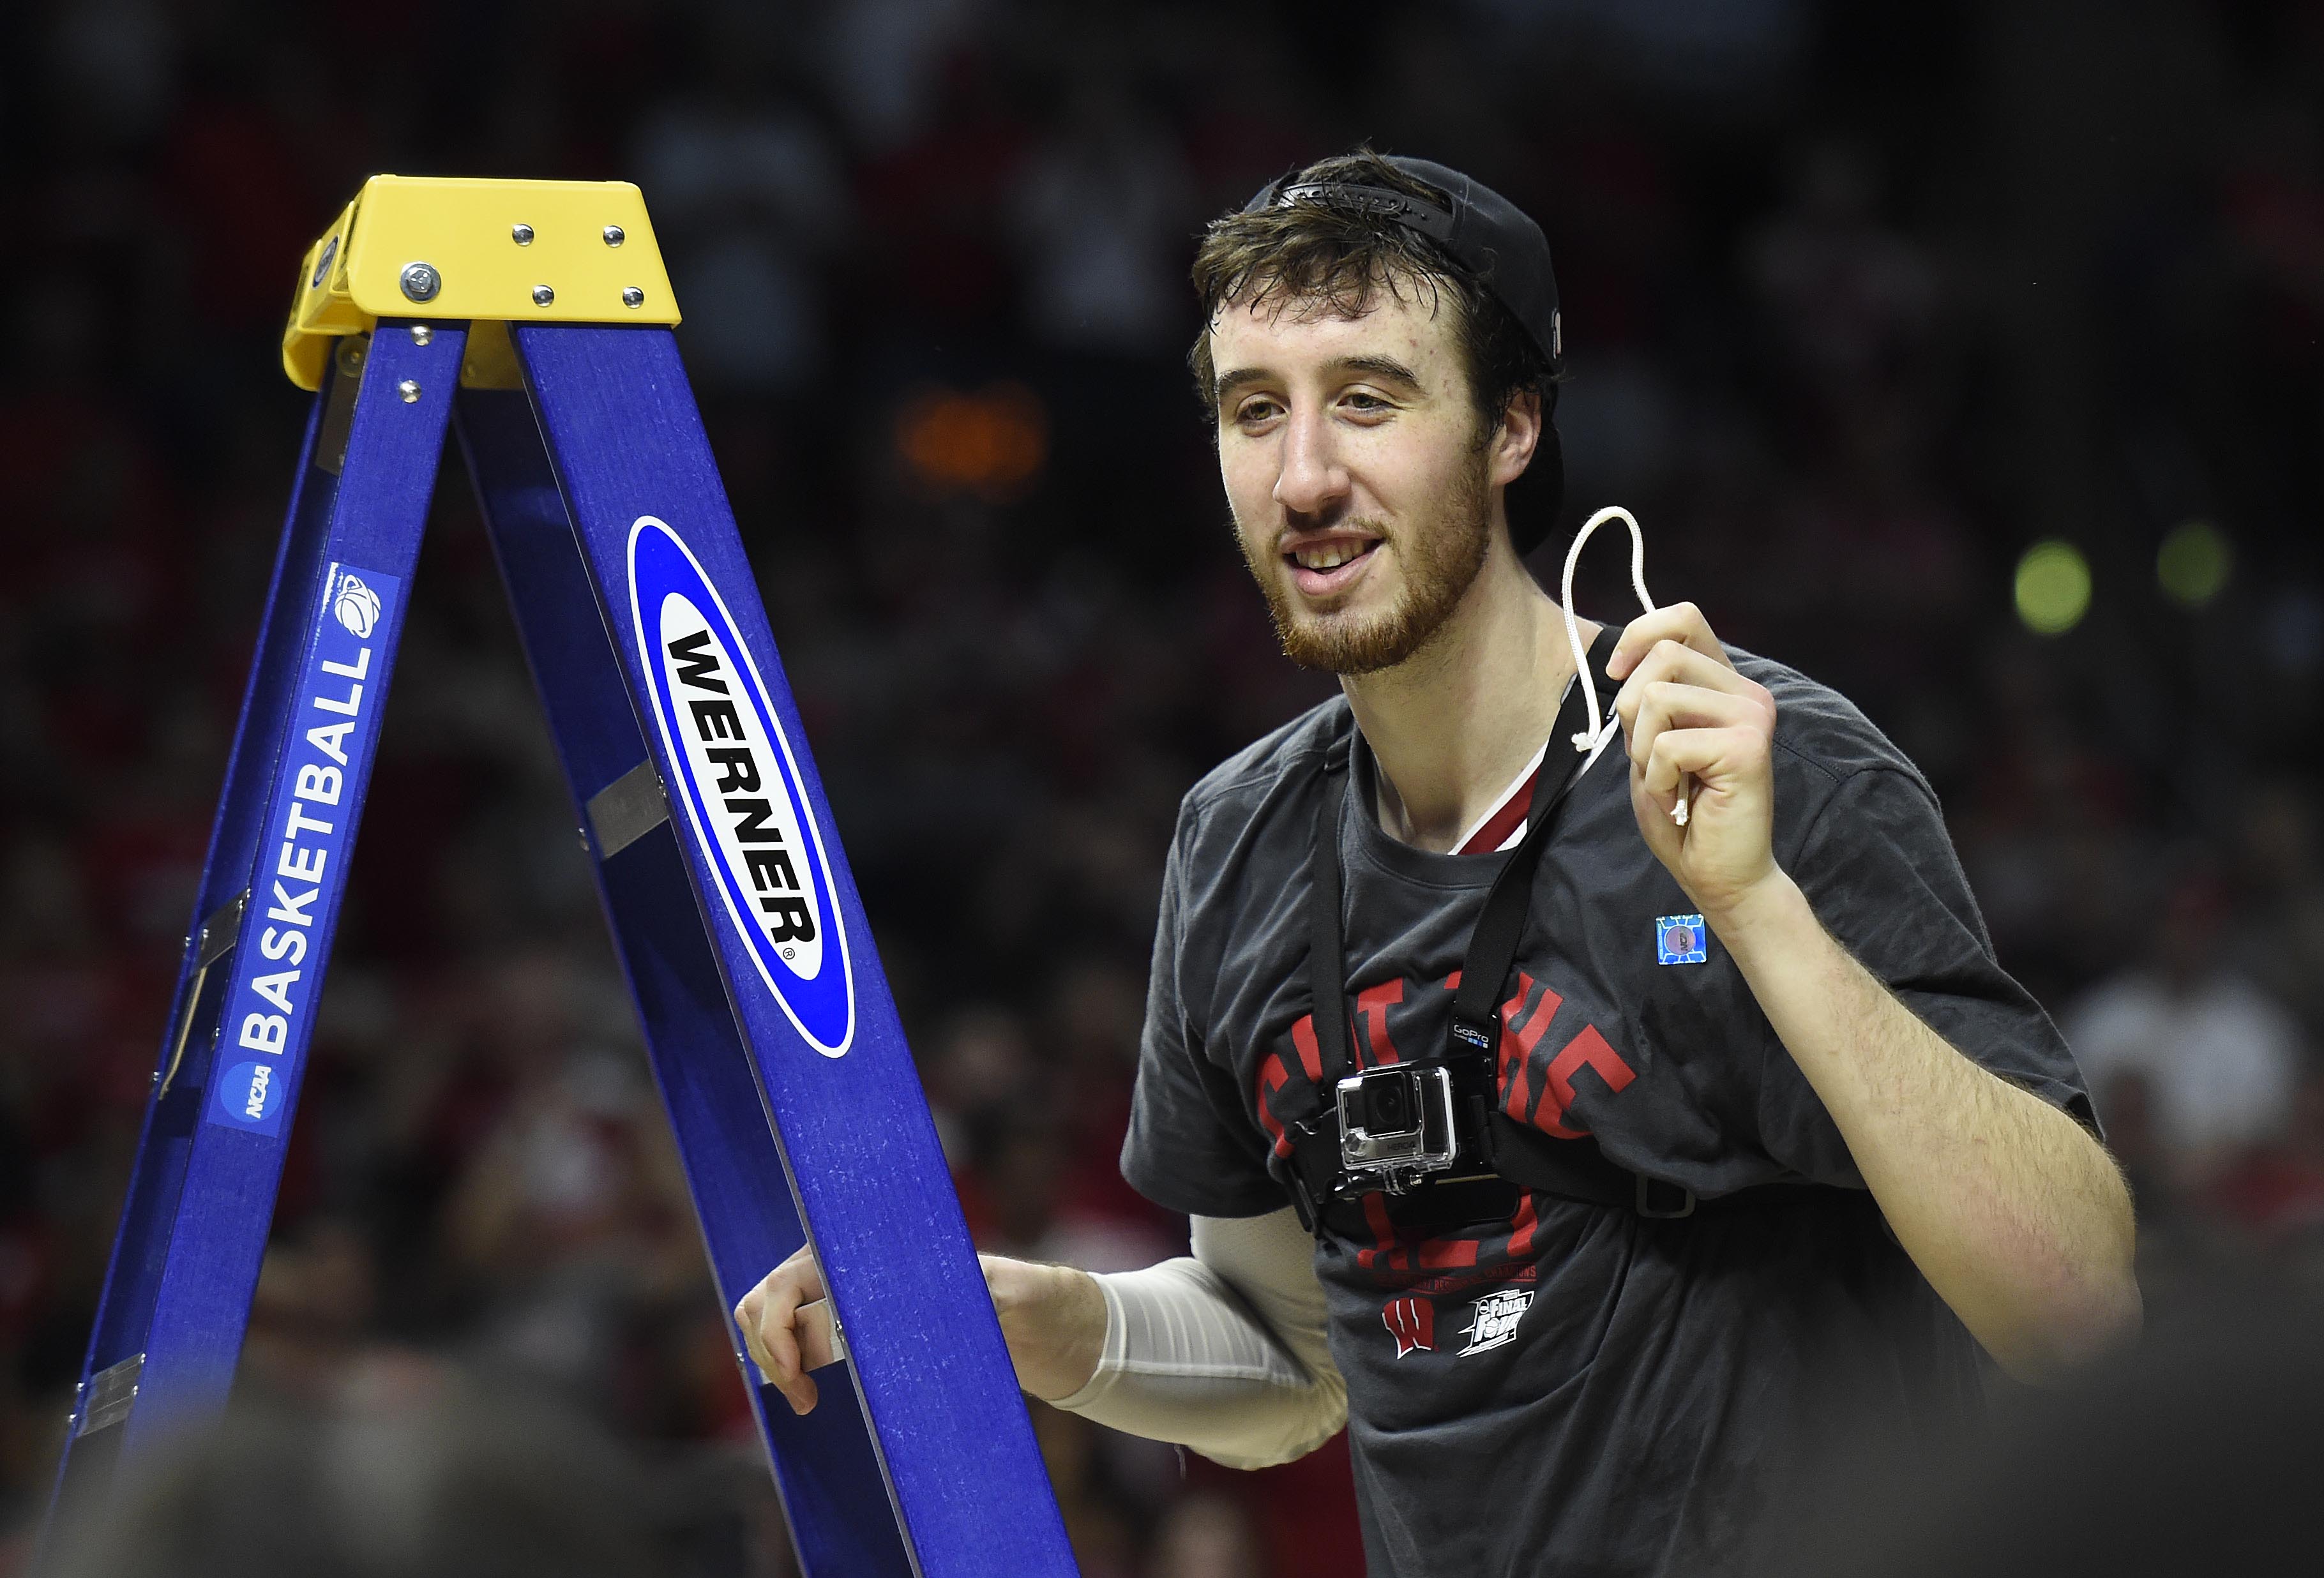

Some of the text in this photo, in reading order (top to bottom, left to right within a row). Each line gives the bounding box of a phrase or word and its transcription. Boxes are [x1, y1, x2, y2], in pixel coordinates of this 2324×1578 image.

[667, 628, 816, 944] WERNER
[238, 647, 372, 1056] BASKETBALL
[1454, 1024, 1489, 1043] GoPro
[245, 1065, 272, 1119] NCAA
[1474, 1311, 1523, 1342] FOUR
[1490, 1296, 1528, 1318] FINAL
